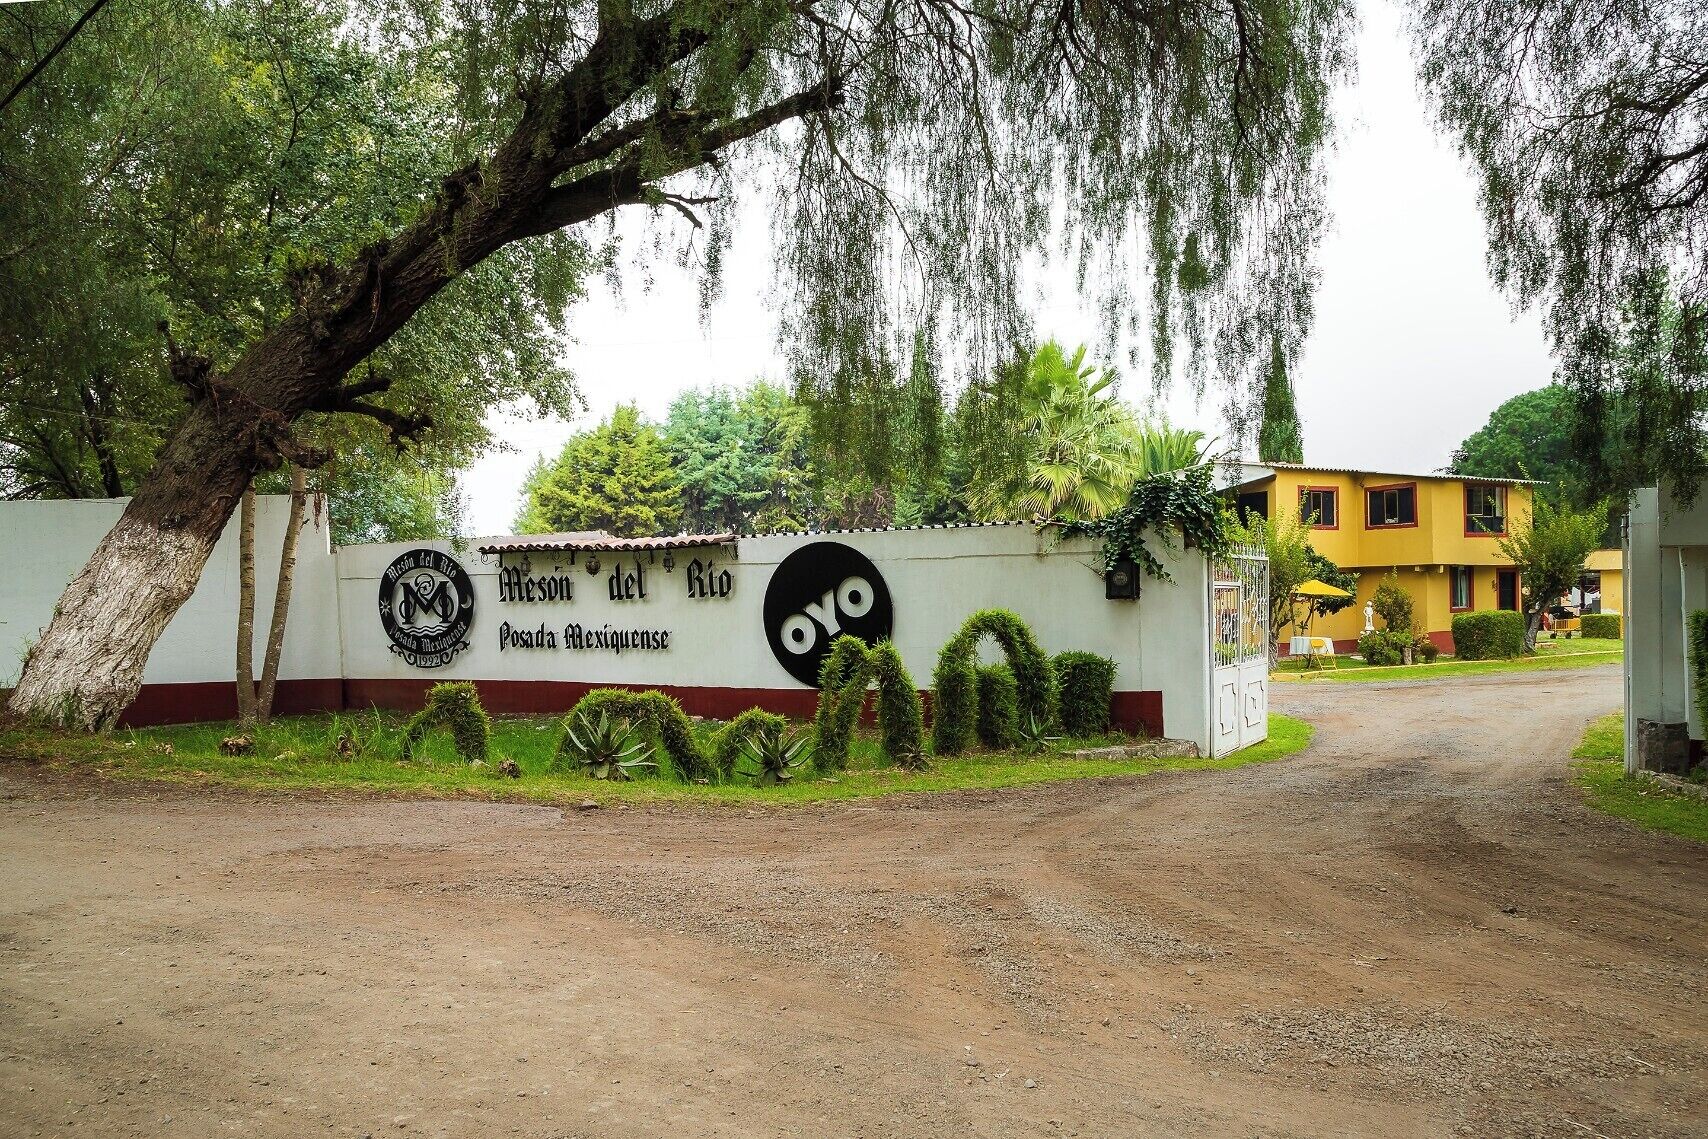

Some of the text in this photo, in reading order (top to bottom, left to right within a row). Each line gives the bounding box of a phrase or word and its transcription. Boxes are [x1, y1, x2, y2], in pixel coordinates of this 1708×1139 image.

[387, 556, 415, 583] Mesón
[420, 552, 434, 568] del
[608, 561, 645, 601] del
[780, 576, 875, 656] OYO
[389, 623, 417, 650] Posada
[499, 620, 669, 654] Posada Mexiquense
[418, 655, 440, 667] 1992
